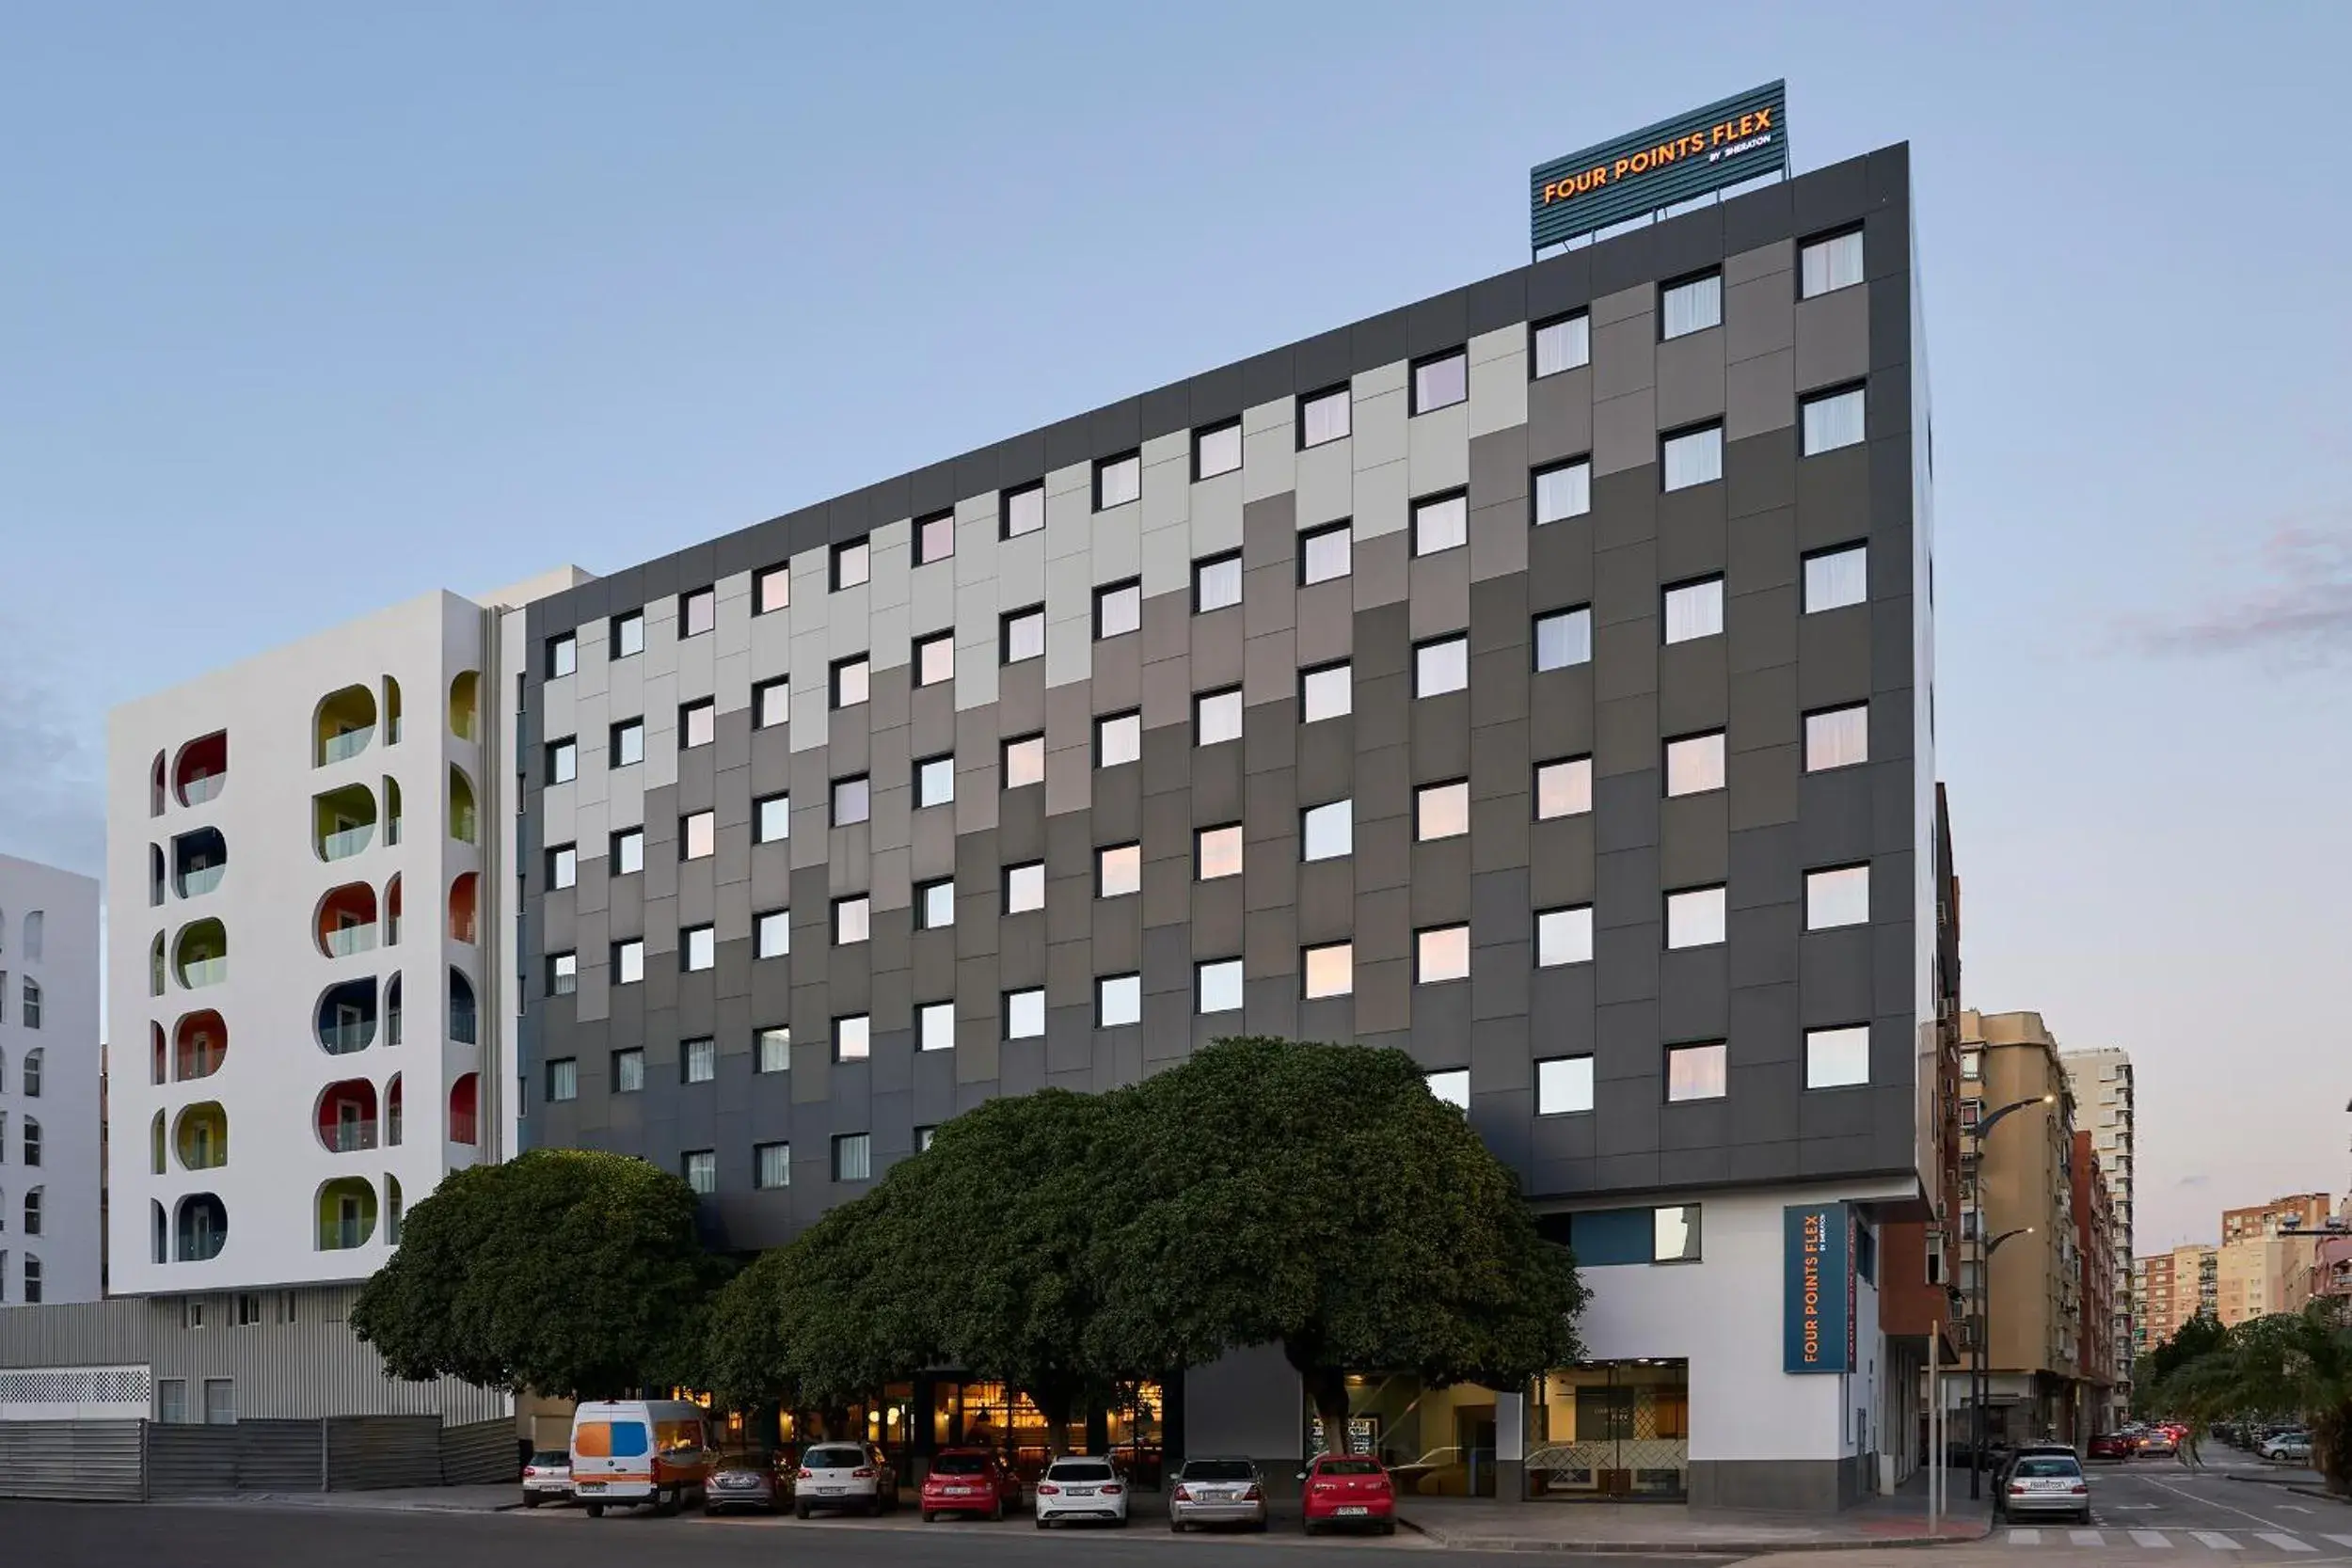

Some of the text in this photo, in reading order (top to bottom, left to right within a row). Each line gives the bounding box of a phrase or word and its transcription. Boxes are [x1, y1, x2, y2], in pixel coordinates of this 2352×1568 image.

[1545, 108, 1772, 203] FOUR POINTS FLEX
[1708, 135, 1772, 162] BY SHERATON
[1804, 1215, 1818, 1362] FOUR POINTS FLEX
